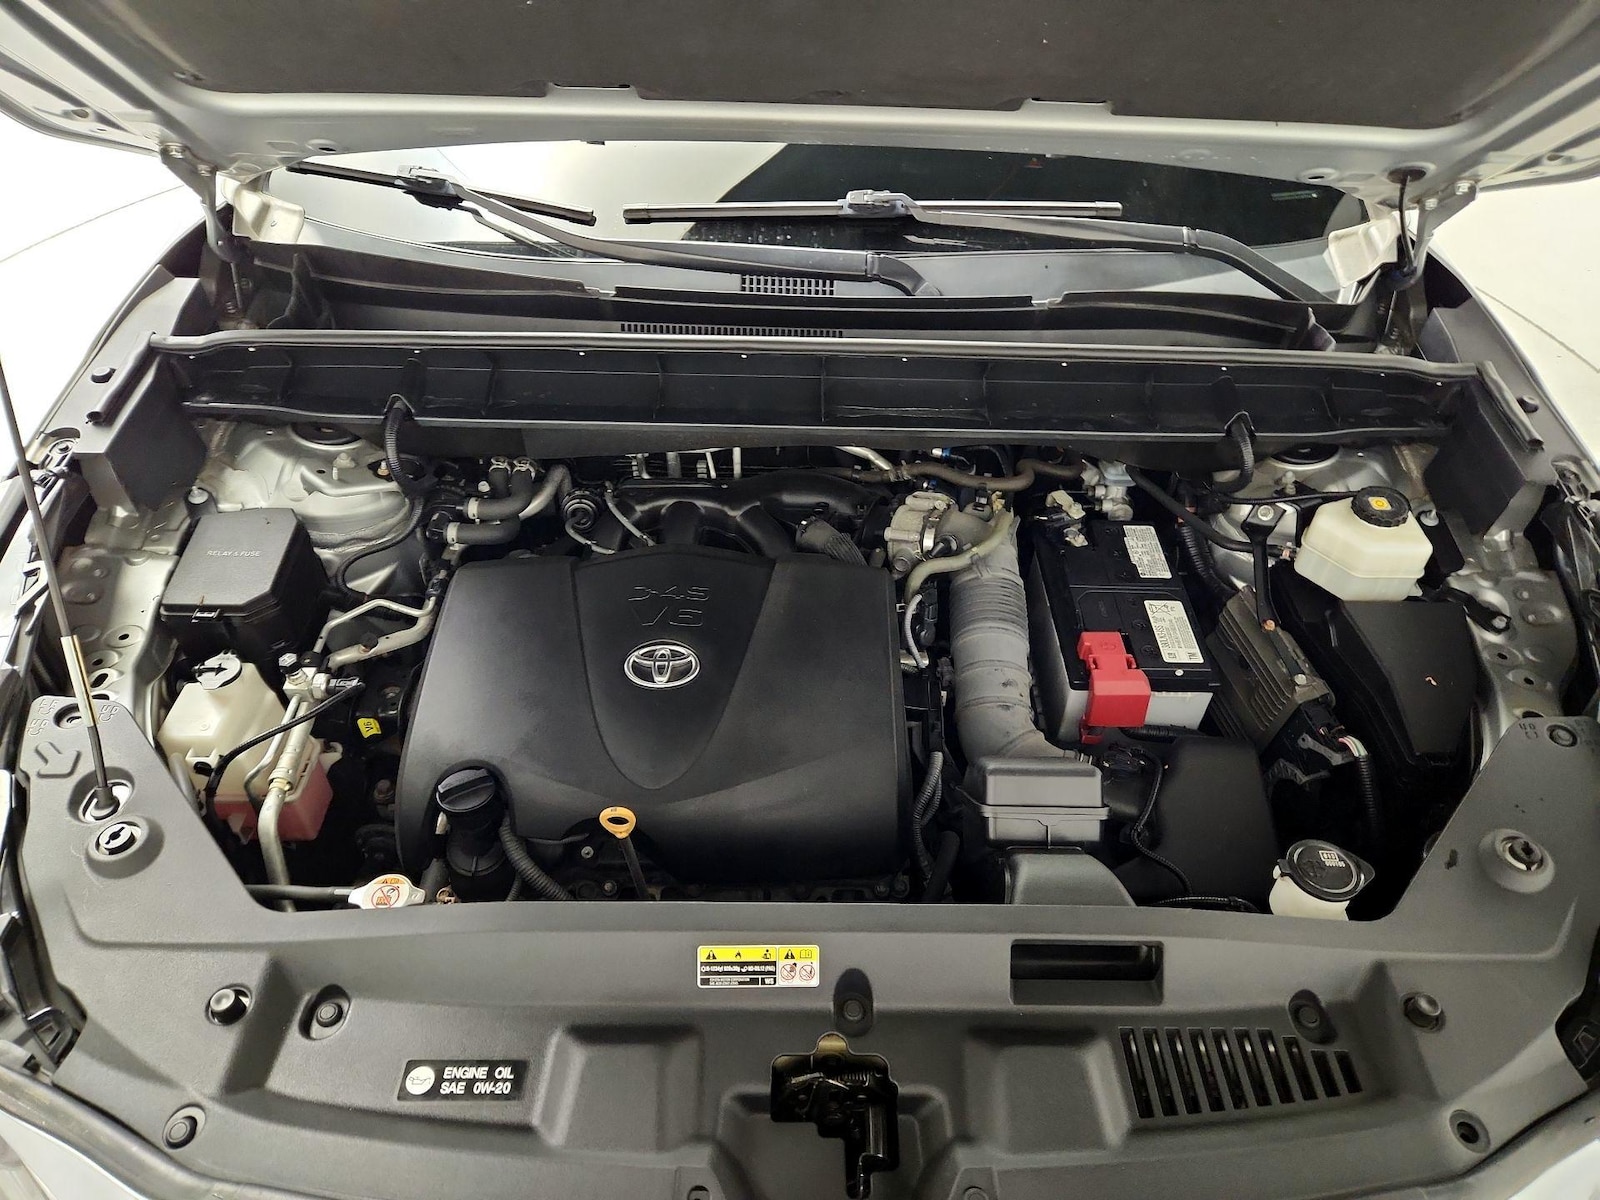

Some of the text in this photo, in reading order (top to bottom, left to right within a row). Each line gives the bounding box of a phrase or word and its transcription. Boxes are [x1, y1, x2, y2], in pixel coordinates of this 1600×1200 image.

[206, 550, 233, 558] RELAY
[240, 550, 261, 558] FUSE
[631, 606, 704, 627] V6
[443, 1066, 515, 1080] ENGINE OIL
[440, 1081, 512, 1095] SAE 0W-20
